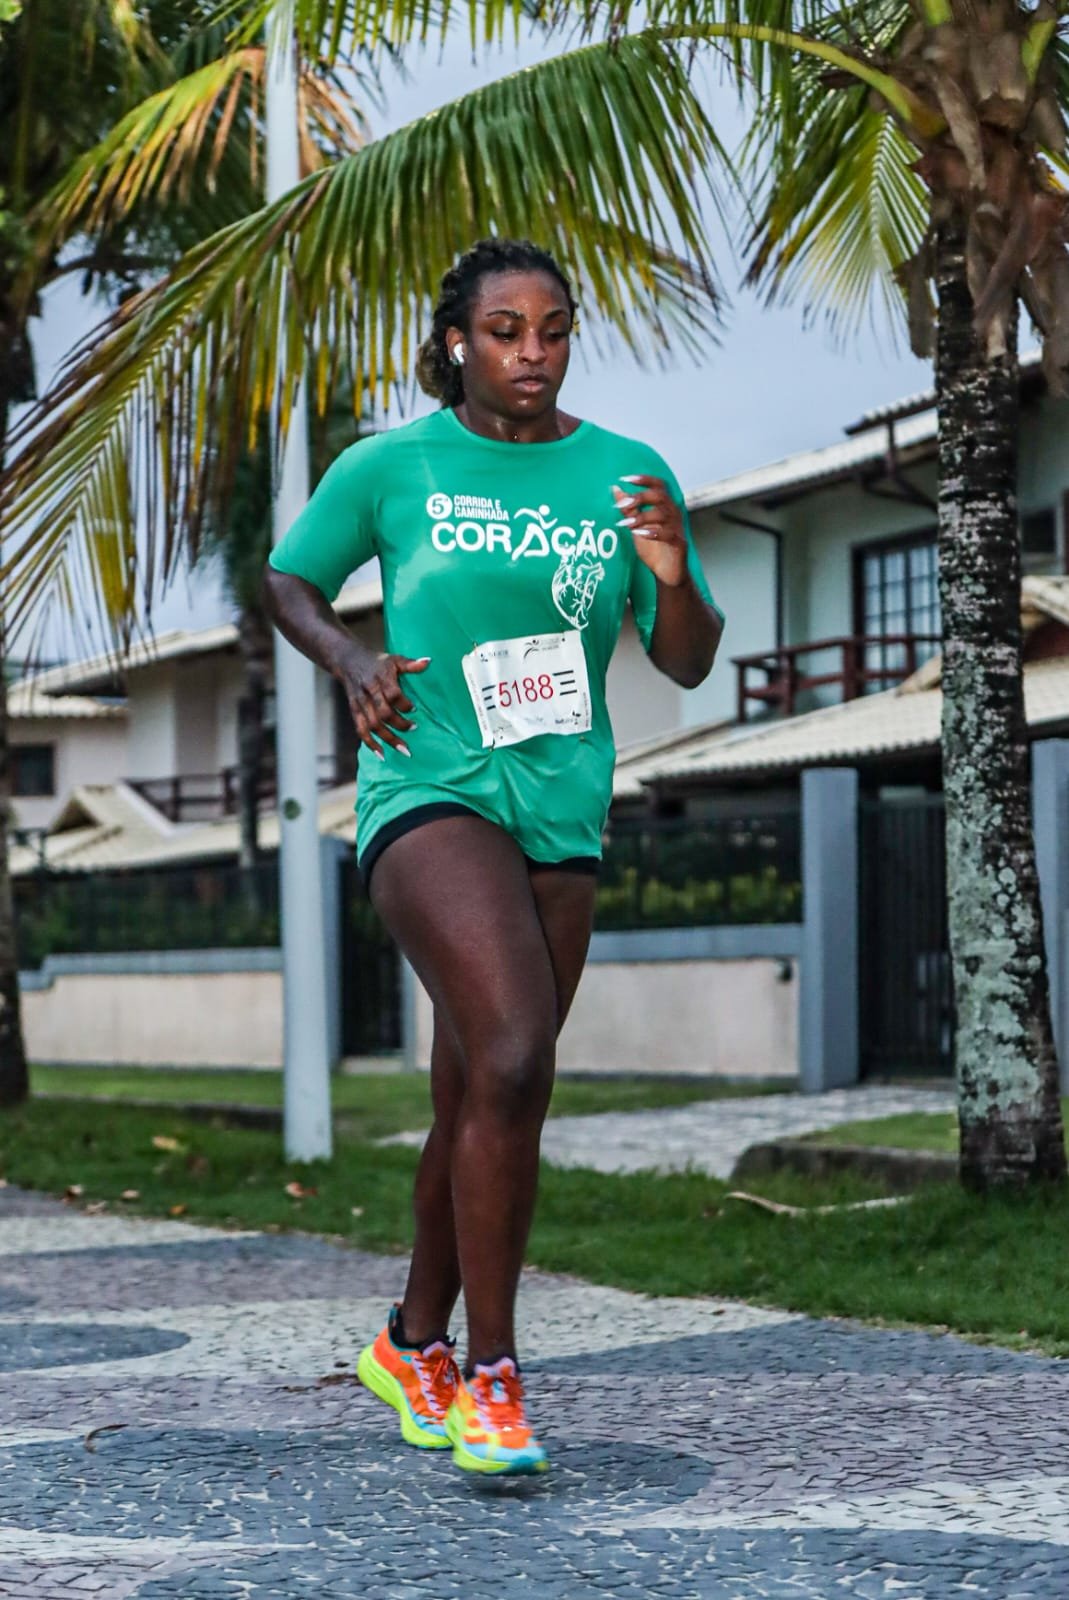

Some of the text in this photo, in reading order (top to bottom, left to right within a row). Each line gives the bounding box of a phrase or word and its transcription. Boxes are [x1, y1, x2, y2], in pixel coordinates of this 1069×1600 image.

[454, 494, 502, 511] CORRIDA E
[454, 505, 510, 522] CAMINHADA
[498, 674, 554, 708] 5188
